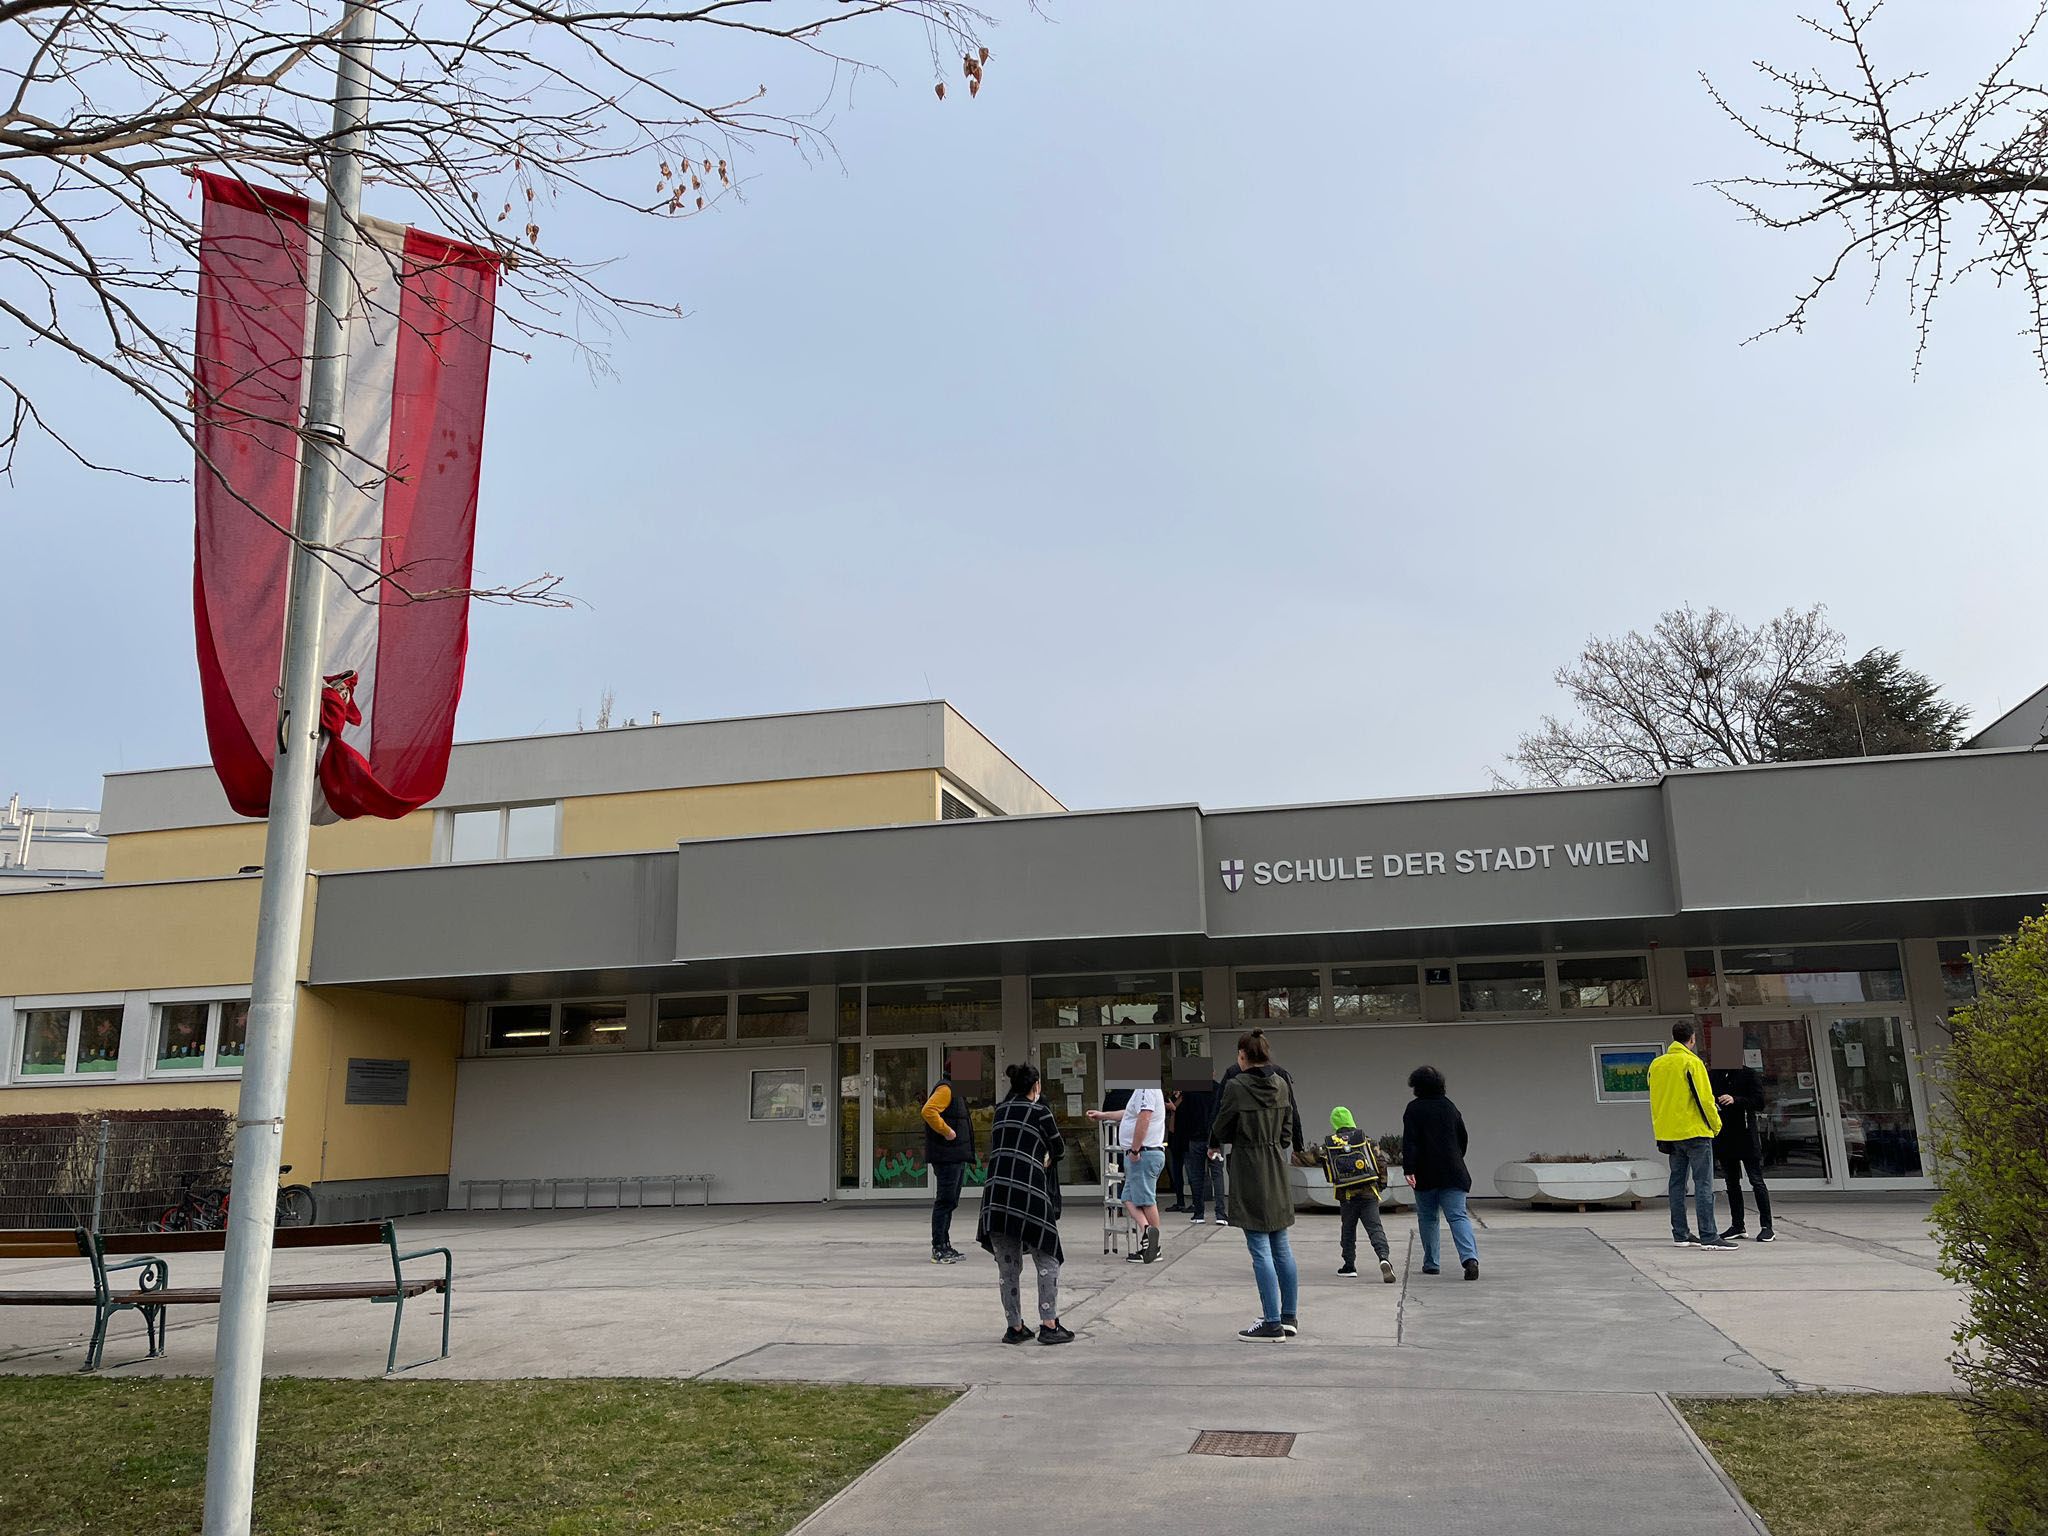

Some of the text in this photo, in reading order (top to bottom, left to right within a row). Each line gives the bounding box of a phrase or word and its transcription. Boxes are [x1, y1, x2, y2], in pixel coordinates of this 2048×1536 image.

[1253, 839, 1649, 885] SCHULE DER STADT WIEN
[1434, 970, 1441, 980] 7
[844, 1135, 854, 1175] SCHULE
